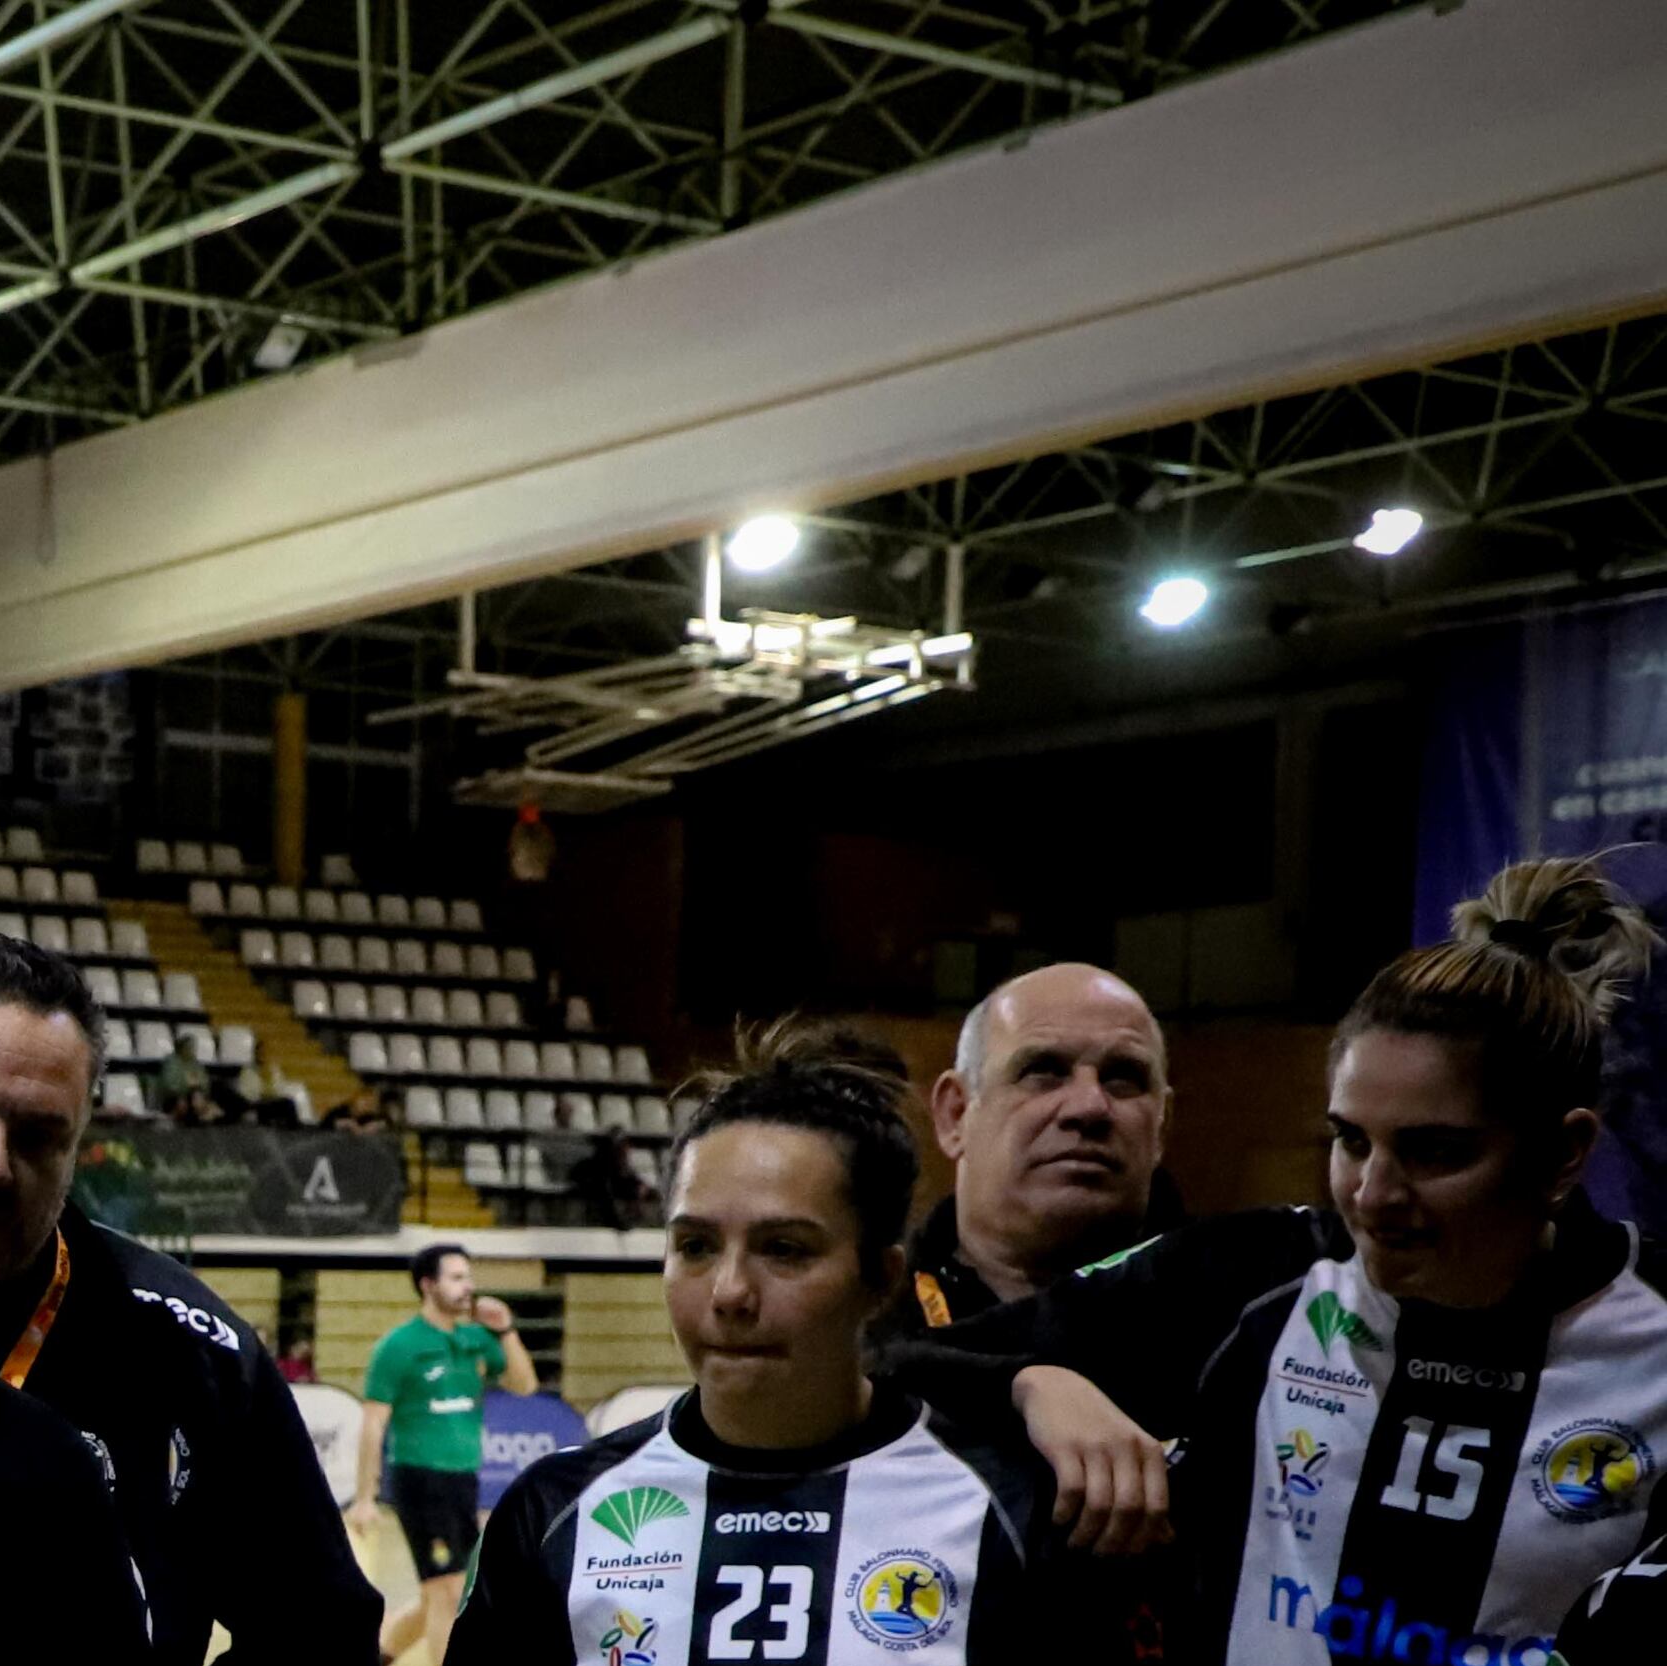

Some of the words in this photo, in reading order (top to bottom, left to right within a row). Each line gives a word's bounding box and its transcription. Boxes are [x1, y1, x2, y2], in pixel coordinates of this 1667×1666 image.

[1283, 1358, 1371, 1389] Fundación
[1408, 1358, 1497, 1388] emec
[1286, 1387, 1347, 1417] Unicaja
[1380, 1415, 1491, 1520] 15
[715, 1511, 806, 1534] emec
[587, 1551, 684, 1571] Fundación
[845, 1573, 862, 1598] CLUB
[859, 1548, 932, 1572] BALONMANO
[596, 1574, 665, 1593] Unicaja
[707, 1565, 814, 1660] 23
[883, 1640, 919, 1652] COSTA
